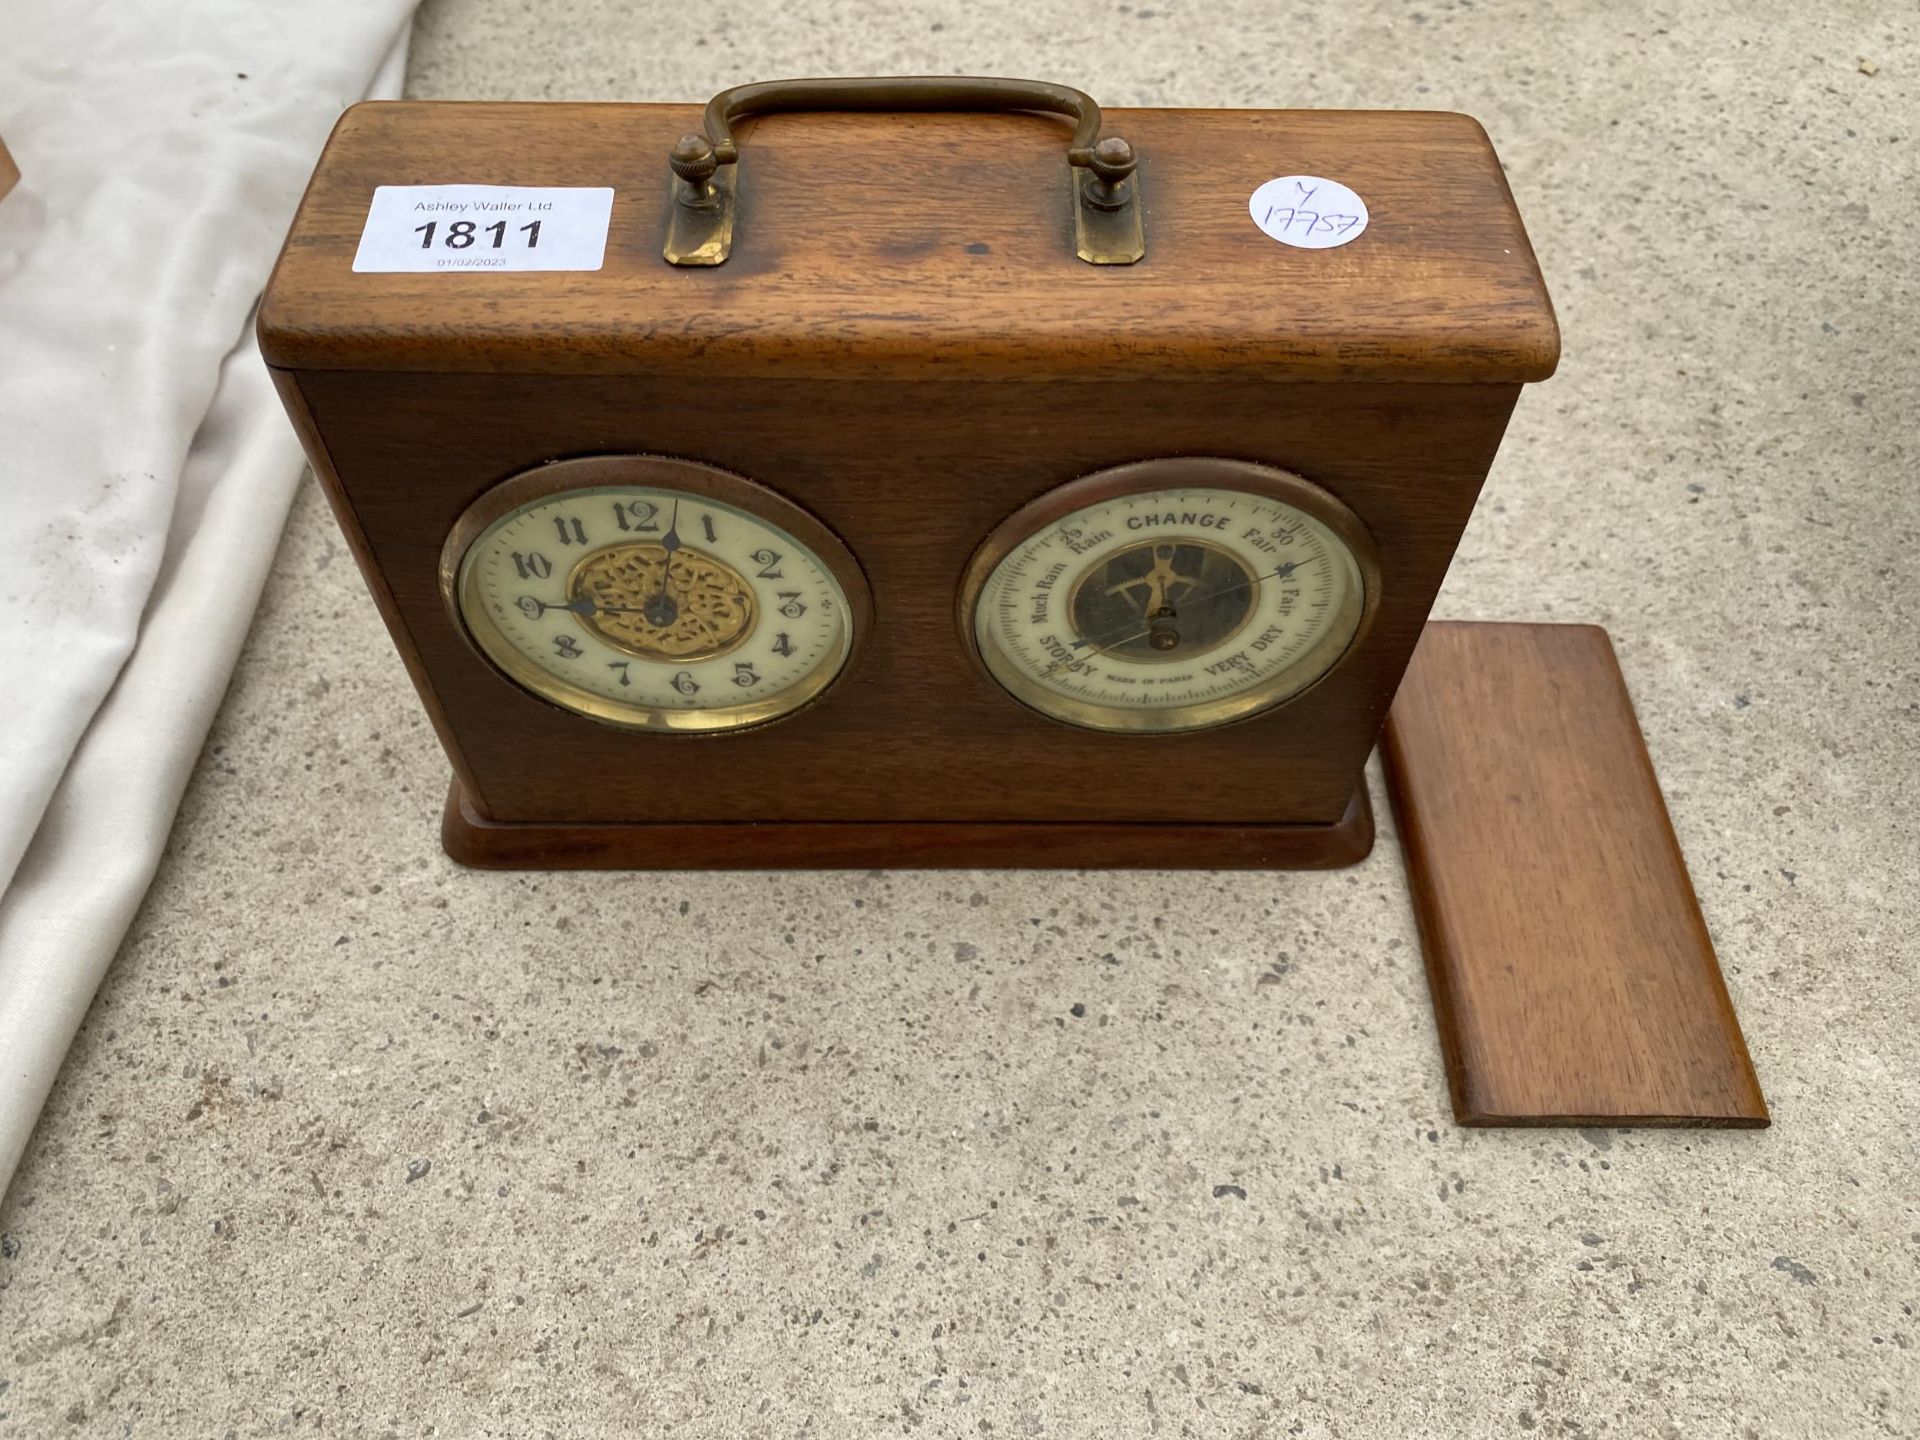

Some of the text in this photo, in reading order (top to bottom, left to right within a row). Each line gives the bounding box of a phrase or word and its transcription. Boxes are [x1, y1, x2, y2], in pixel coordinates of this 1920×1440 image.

[414, 201, 553, 214] Ashley Waller Ltd
[414, 220, 542, 249] 1811
[437, 257, 507, 267] 01/02/2023
[613, 501, 659, 532] 12
[701, 513, 718, 545] 1
[1126, 512, 1231, 531] CHANGE
[553, 516, 589, 546] 11
[1059, 528, 1083, 547] 29
[1069, 528, 1115, 556] Rain
[1240, 527, 1278, 554] Fair
[1270, 527, 1295, 547] 30
[510, 551, 552, 580] 10
[750, 549, 784, 580] 2
[777, 591, 808, 619] 3
[1030, 562, 1068, 624] Much Rain
[1277, 588, 1300, 617] Fair
[514, 596, 546, 621] 9
[552, 634, 584, 659] 8
[771, 632, 798, 659] 4
[1203, 624, 1284, 677] VERY DRY
[606, 661, 631, 687] 7
[670, 671, 700, 697] 6
[731, 662, 762, 688] 5
[1105, 673, 1194, 685] MADE IN PARIS
